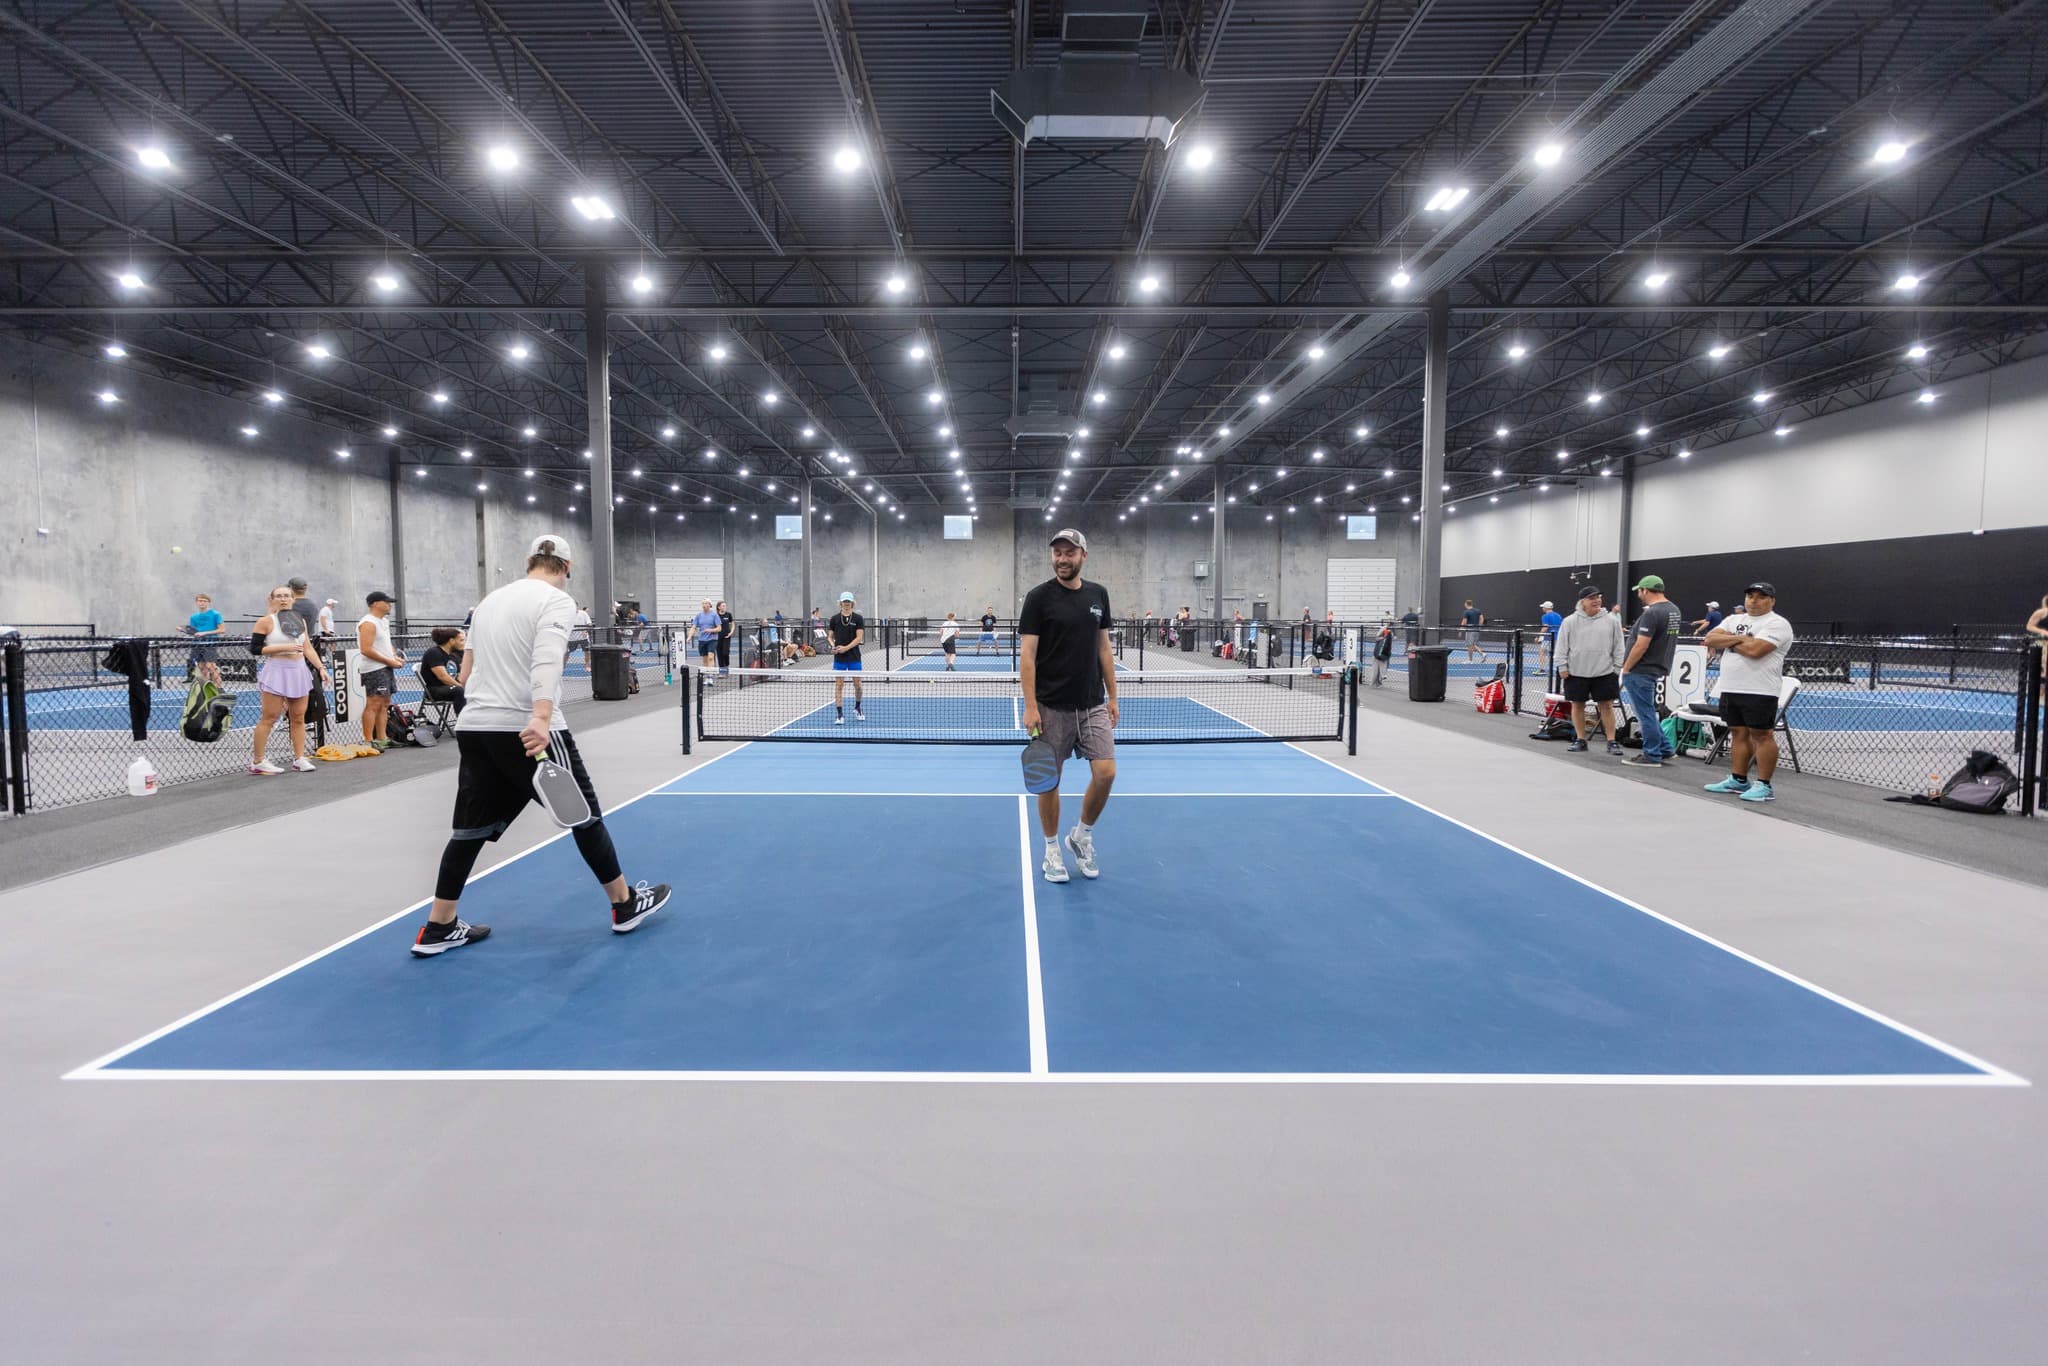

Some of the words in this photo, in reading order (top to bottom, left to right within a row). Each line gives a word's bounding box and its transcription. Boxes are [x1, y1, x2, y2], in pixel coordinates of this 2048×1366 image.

[1679, 661, 1692, 684] 2
[1798, 666, 1844, 676] JOOLA
[334, 659, 347, 714] COURT
